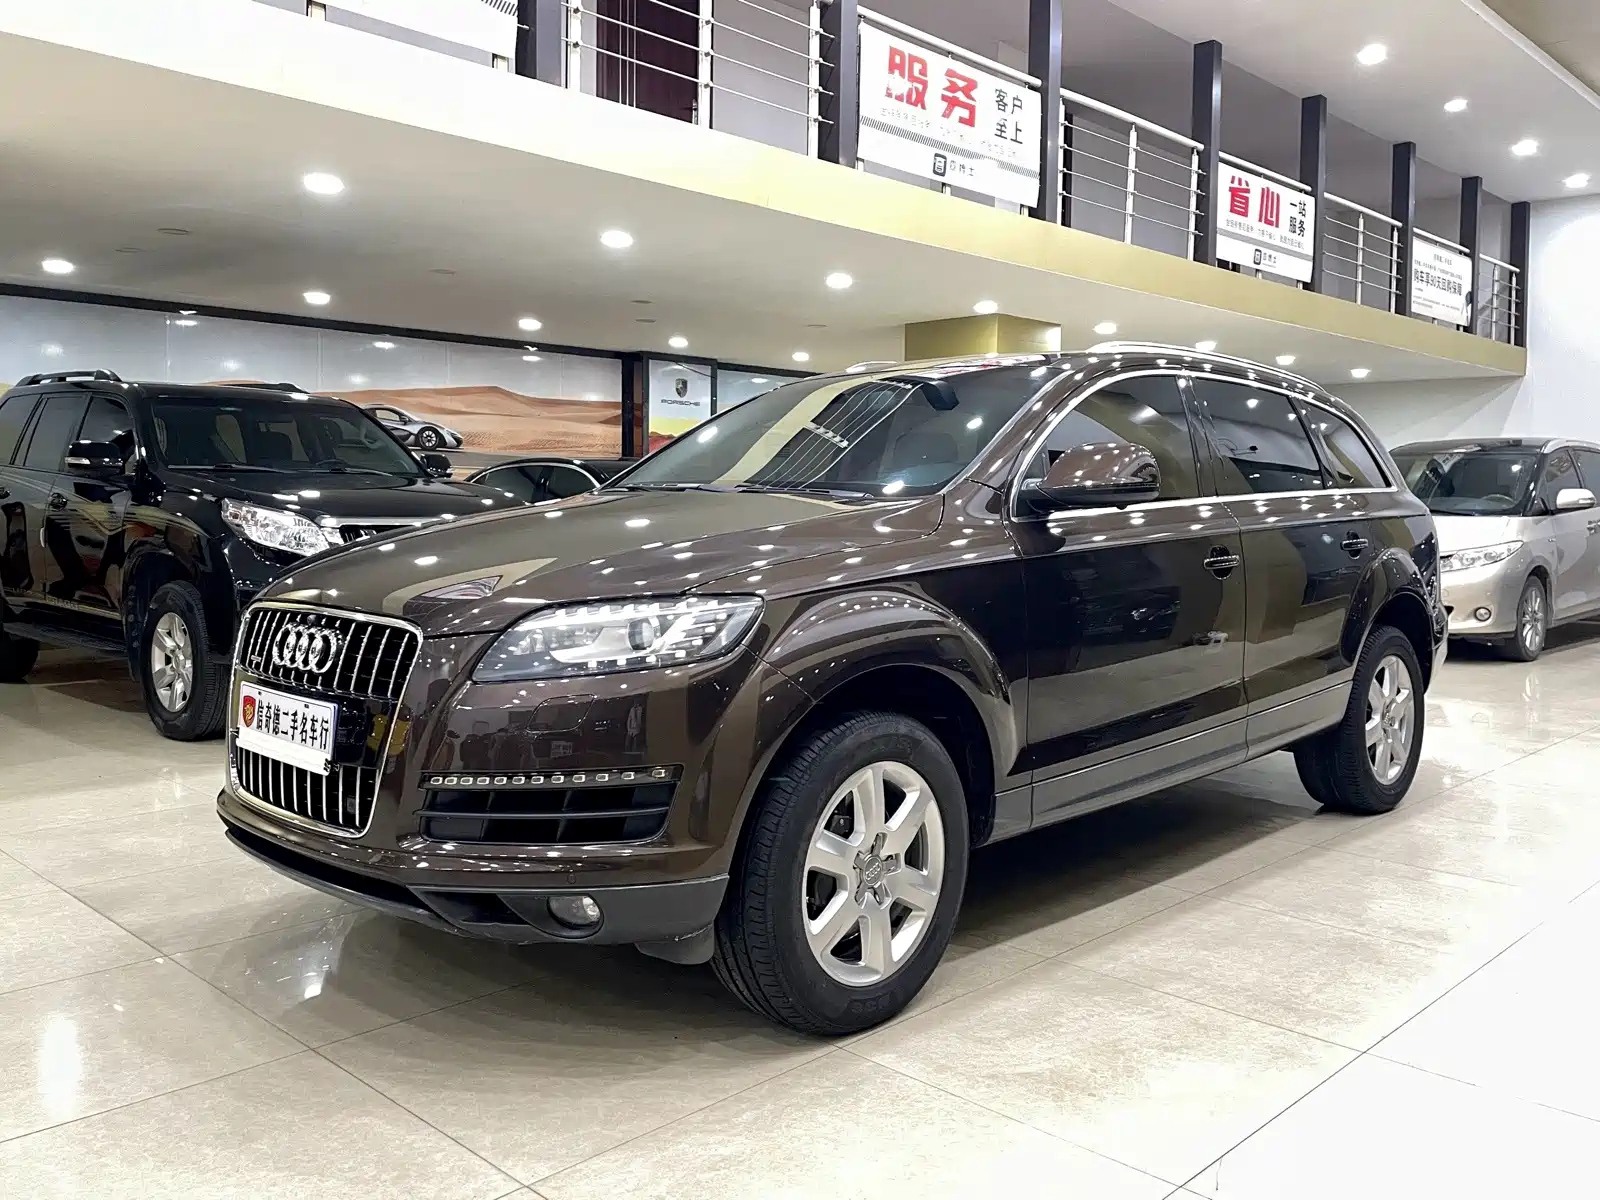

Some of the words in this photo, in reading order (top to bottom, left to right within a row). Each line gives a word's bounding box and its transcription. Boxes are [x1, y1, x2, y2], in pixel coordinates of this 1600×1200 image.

[885, 46, 977, 127] 服务
[994, 88, 1023, 115] 客户
[994, 118, 1023, 144] 至上
[1228, 175, 1280, 228] 省心
[1290, 200, 1306, 217] 一站
[1289, 216, 1305, 237] 服务
